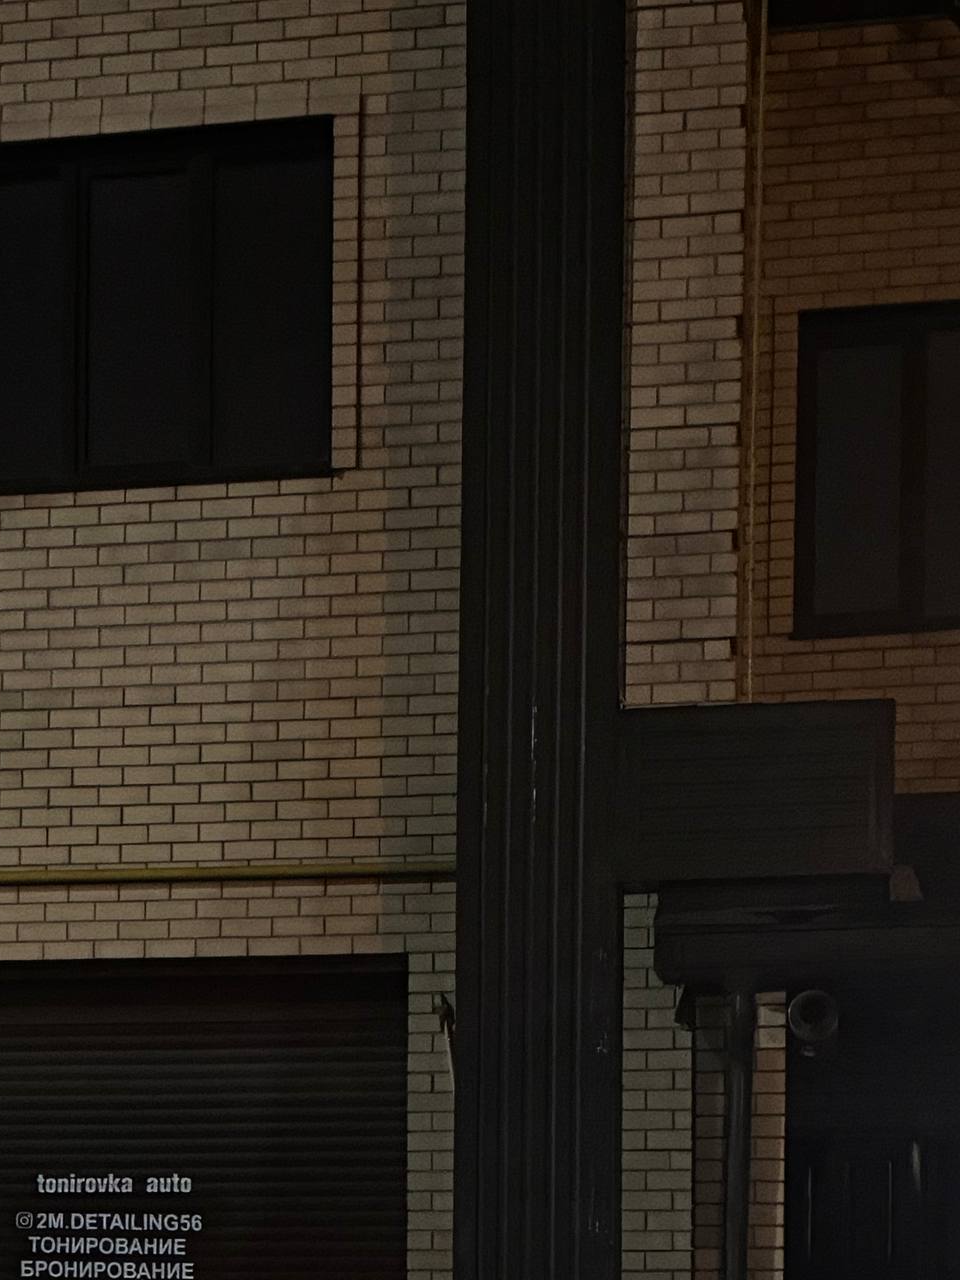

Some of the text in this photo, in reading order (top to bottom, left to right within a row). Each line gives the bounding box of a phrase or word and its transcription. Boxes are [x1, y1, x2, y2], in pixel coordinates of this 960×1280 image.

[36, 1173, 192, 1194] tonirovka auto
[36, 1212, 203, 1232] 2M.DETAILING56
[28, 1236, 187, 1256] ТОНИРОВАНИЕ
[20, 1260, 195, 1280] БРОНИРОВАНИЕ
